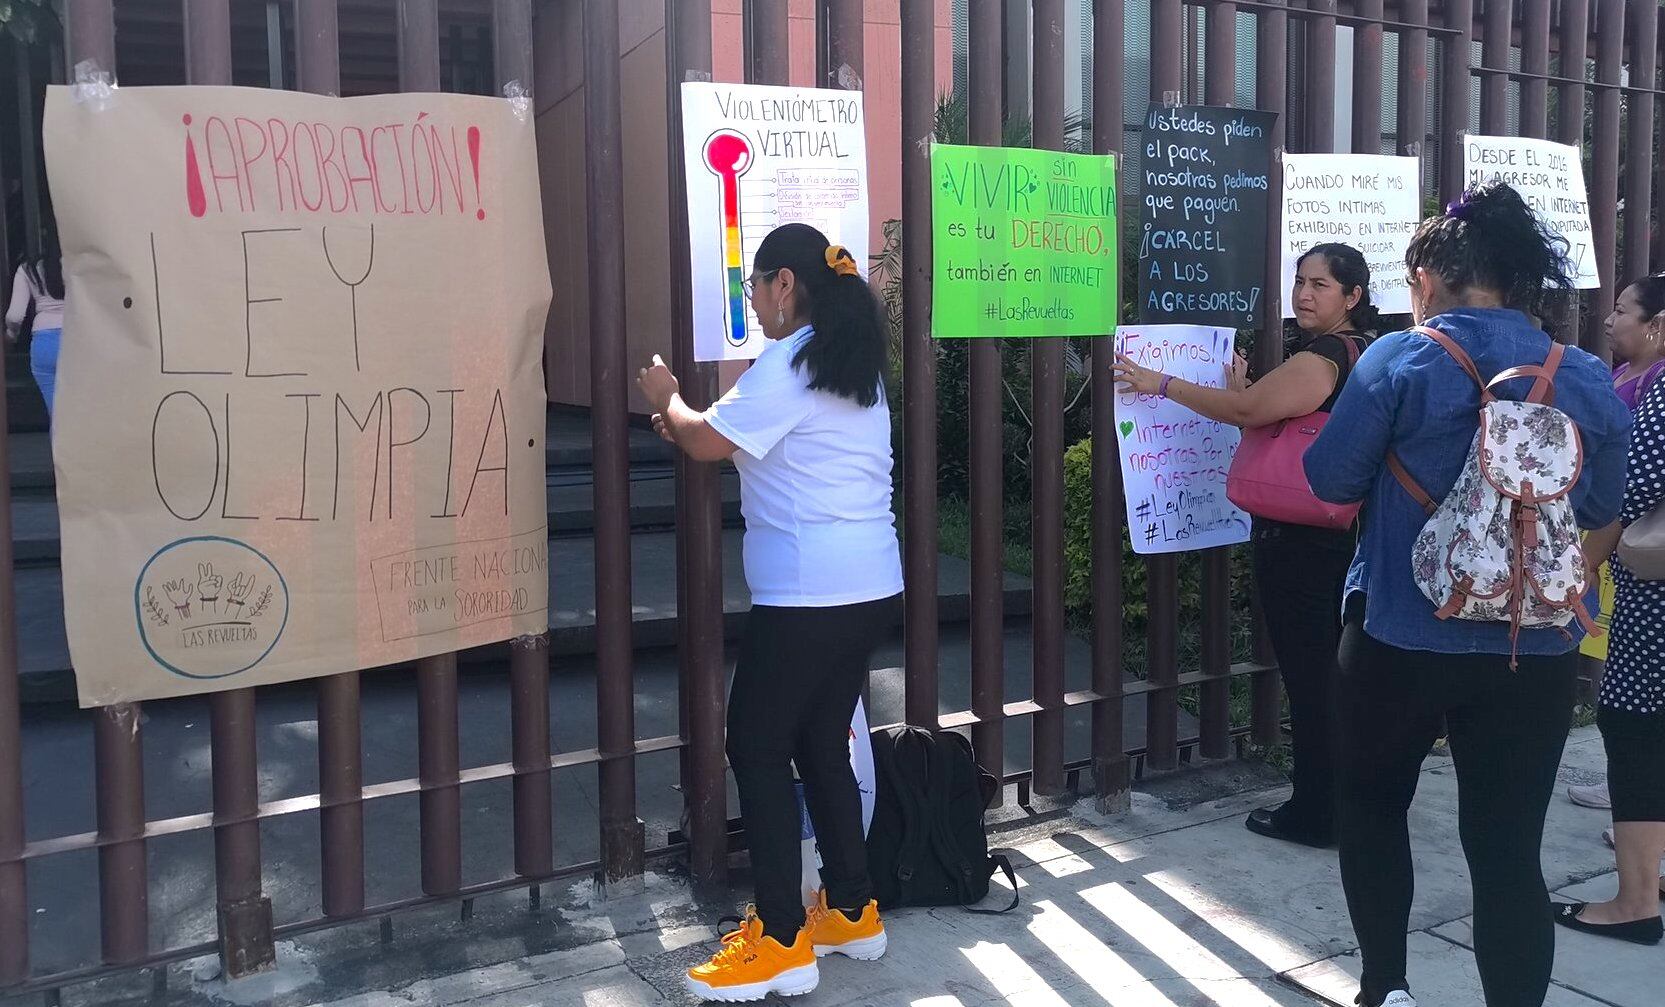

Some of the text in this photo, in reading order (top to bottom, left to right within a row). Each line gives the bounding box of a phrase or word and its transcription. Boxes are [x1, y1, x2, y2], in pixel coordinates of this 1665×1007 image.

[715, 91, 858, 124] VIOLENTÓMETRO
[1149, 109, 1263, 145] Ustedes piden
[757, 129, 849, 158] VIRTUAL
[1146, 140, 1216, 167] el pack,
[1469, 143, 1516, 165] DESDE
[1526, 149, 1540, 166] EL
[182, 112, 487, 221] ¡APROBACIÓN!
[1285, 163, 1403, 191] CUANDO MIRÉ MIS
[944, 157, 1077, 213] VIVIR sin
[1146, 167, 1268, 195] nosotras pedimos
[1494, 171, 1551, 188] AGRESOR
[1556, 176, 1569, 191] ME
[1047, 182, 1116, 216] VIOLENCIA
[1145, 195, 1240, 225] que paguen.
[1287, 198, 1386, 215] FOTOS INTIMAS
[1528, 196, 1587, 215] EN INTERNET
[948, 217, 1111, 256] es tu DERECHO,
[1289, 220, 1419, 235] EXHIBIDAS EN INTERNET
[1290, 240, 1396, 254] ME SUICIDAR
[947, 260, 1104, 288] también en INTERNET
[1149, 260, 1209, 283] A LOS
[151, 223, 375, 377] LEY
[985, 296, 1075, 321] #LasRevueltas
[1147, 288, 1261, 322] AGRESORES!
[152, 388, 509, 521] OLIMPIA
[390, 556, 461, 592] FRENTE
[407, 588, 529, 622] PARA LA SORORIDAD
[182, 626, 257, 648] LAS REVUELTAS
